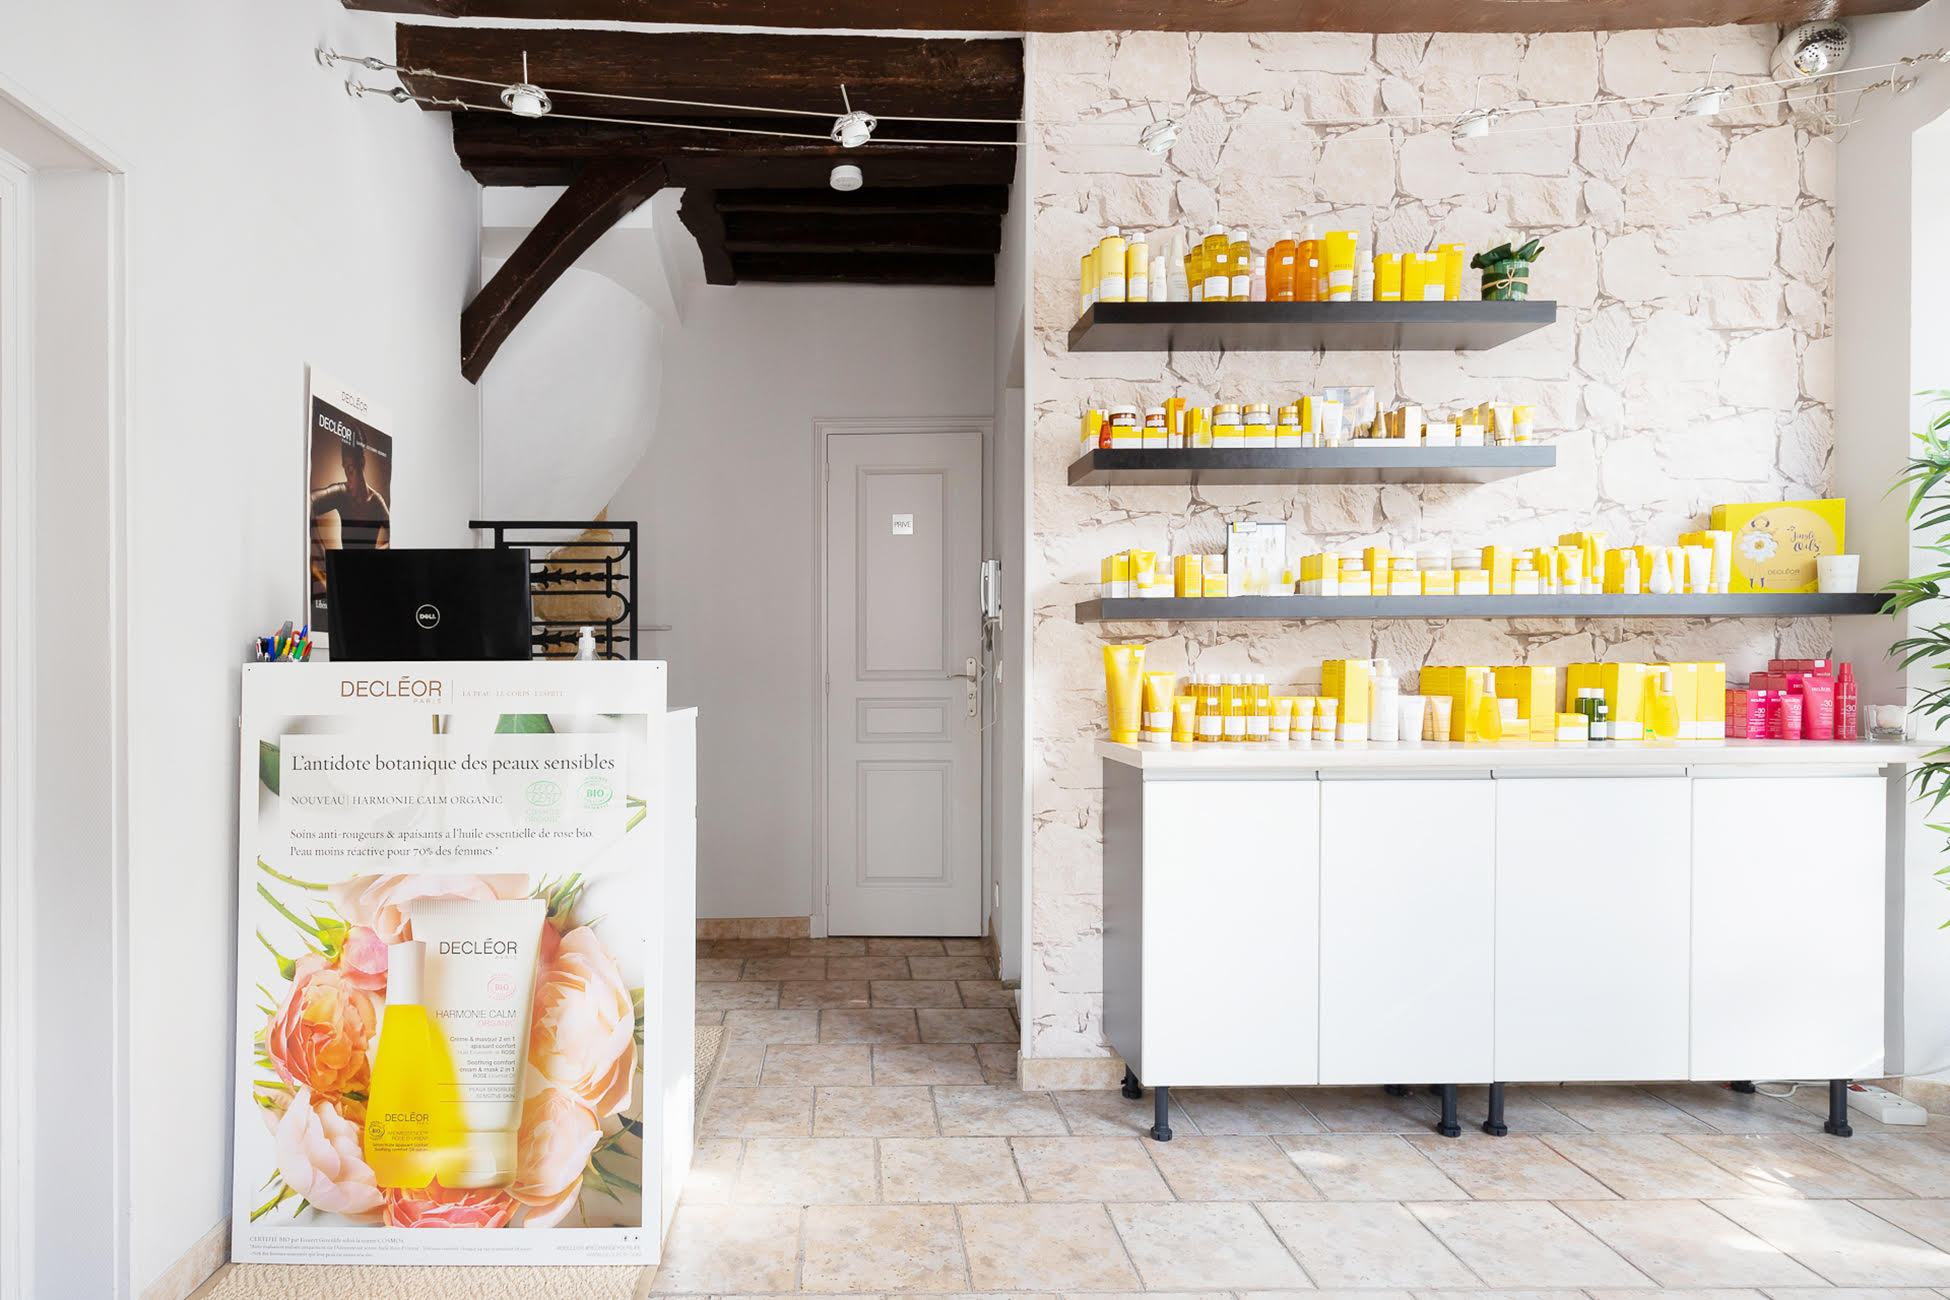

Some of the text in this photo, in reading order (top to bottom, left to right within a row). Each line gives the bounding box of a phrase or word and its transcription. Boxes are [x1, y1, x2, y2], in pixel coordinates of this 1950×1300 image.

[318, 413, 352, 441] DECLÉOR
[340, 675, 442, 697] DECLÉOR
[375, 754, 457, 775] botanique
[461, 753, 488, 770] des
[492, 758, 540, 775] peaux
[543, 753, 615, 770] sensibles
[586, 788, 604, 798] BIO
[291, 795, 503, 805] NOUVEAU HARMONIE CALM ORGANIC
[290, 829, 316, 839] Soins
[318, 829, 385, 842] anti-rougeurs
[386, 830, 395, 839] &
[397, 829, 443, 842] apaisants
[485, 828, 536, 839] essentielle
[538, 828, 550, 839] de
[553, 830, 574, 839] rose
[290, 846, 312, 856] Peau
[315, 846, 345, 856] moins
[387, 848, 410, 859] pour
[413, 847, 433, 857] 70%
[435, 846, 452, 856] des
[439, 937, 518, 955] DECLÉOR
[436, 1009, 517, 1019] HARMONIE CALM
[384, 1111, 430, 1122] DECLÉOR
